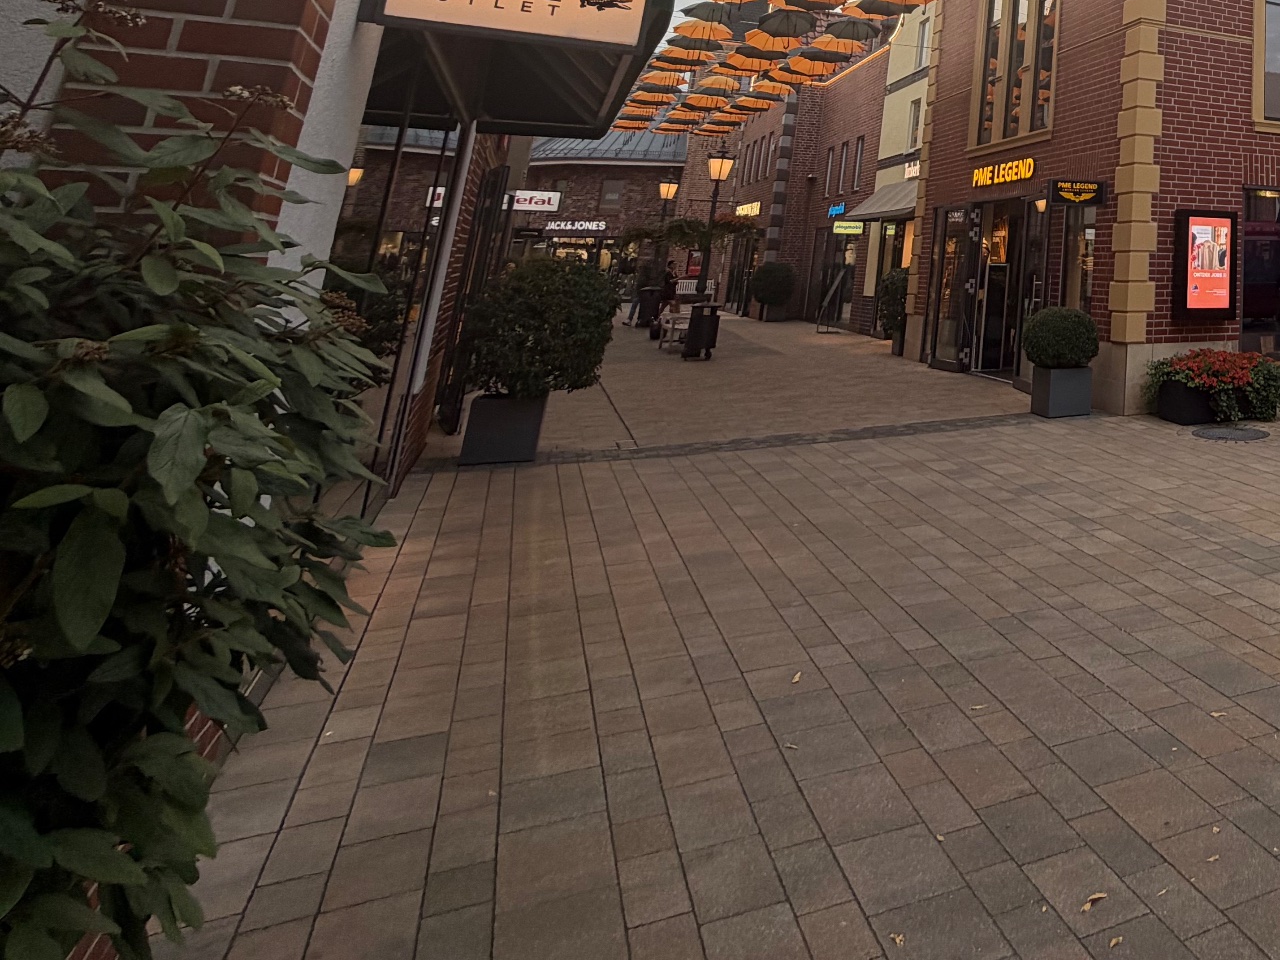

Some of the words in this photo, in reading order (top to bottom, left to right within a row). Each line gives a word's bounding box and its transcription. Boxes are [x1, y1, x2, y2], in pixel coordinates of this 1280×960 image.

[972, 166, 994, 187] PME
[993, 158, 1035, 184] LEGEND
[1057, 181, 1072, 189] PME
[1072, 182, 1098, 190] LEGEND
[515, 195, 555, 206] efal
